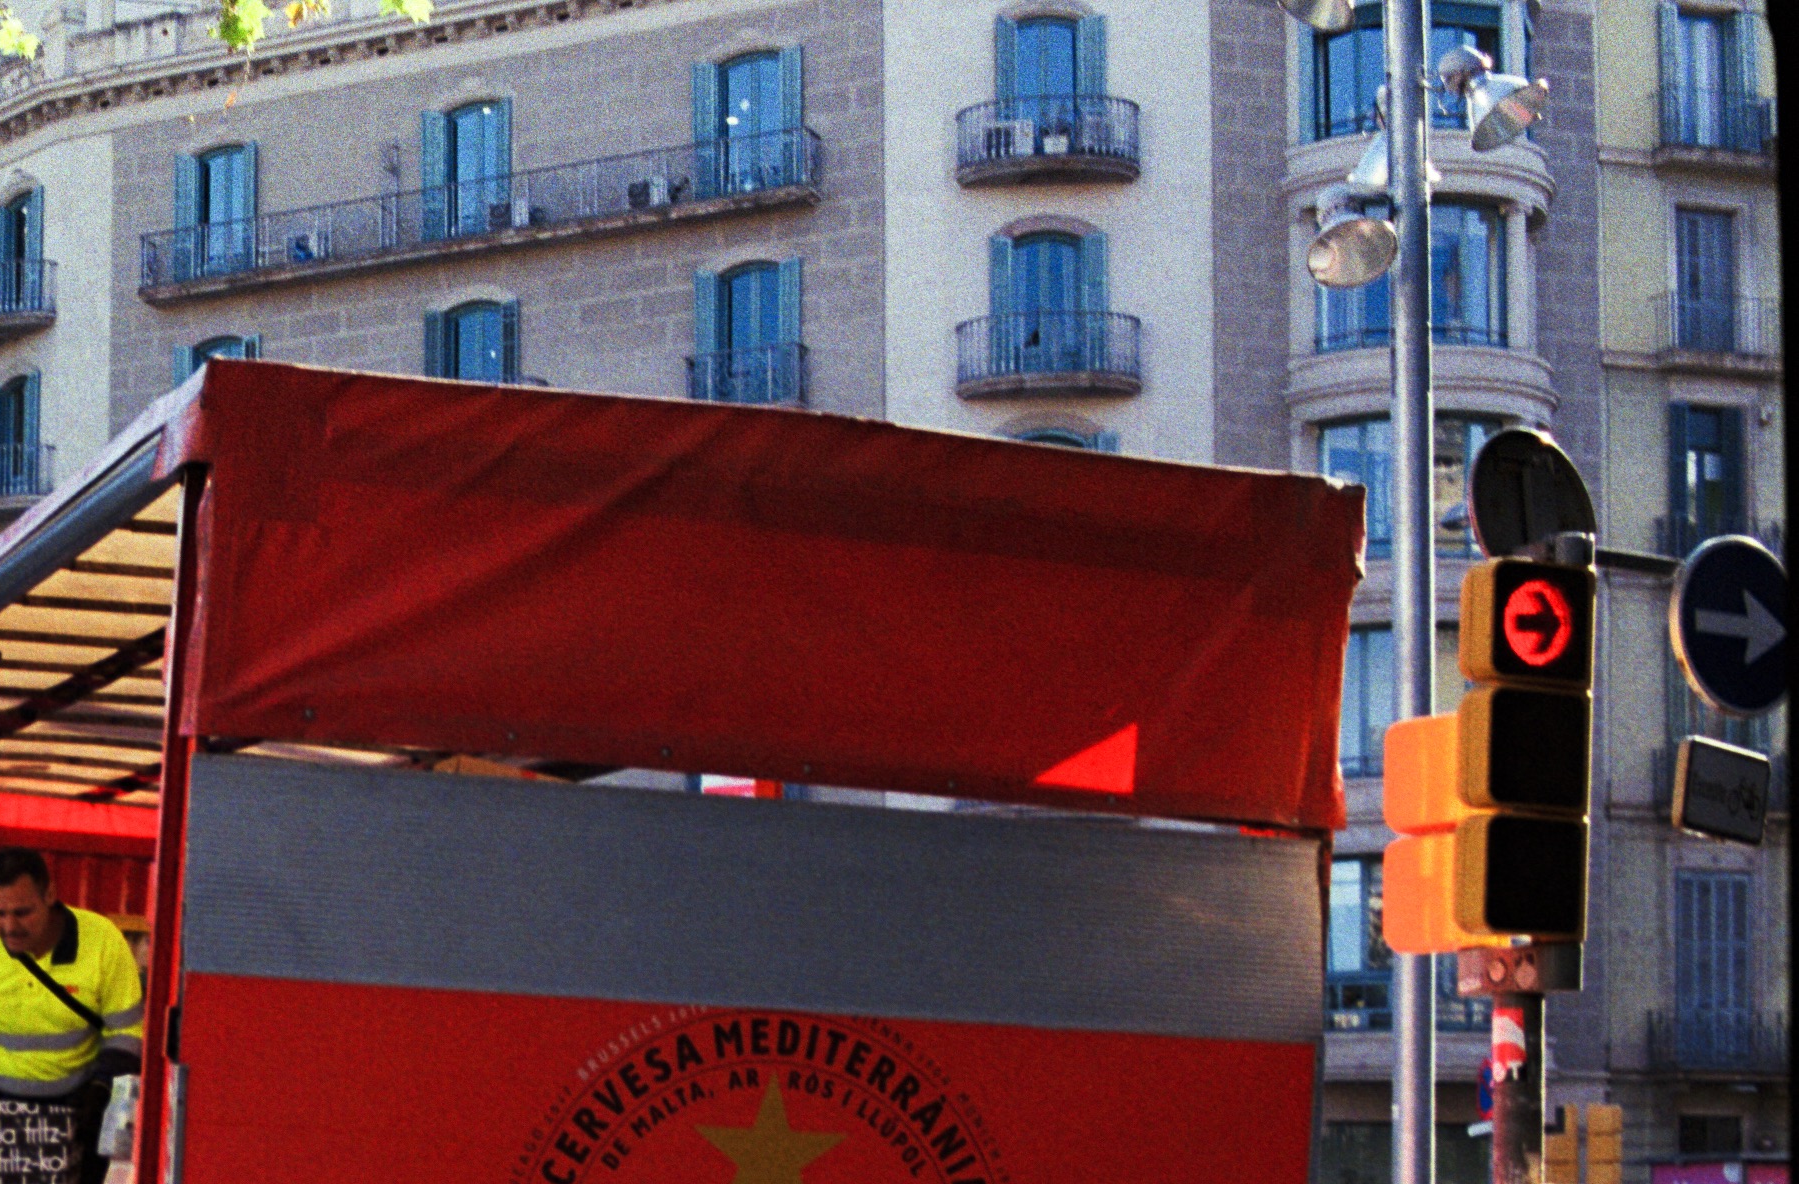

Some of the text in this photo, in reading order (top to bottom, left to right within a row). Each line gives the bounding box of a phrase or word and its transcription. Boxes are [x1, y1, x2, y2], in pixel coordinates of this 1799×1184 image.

[602, 1140, 632, 1170] DE
[630, 1077, 715, 1135] MALTA,
[840, 1087, 853, 1107] I
[856, 1099, 926, 1180] LLÚPOL
